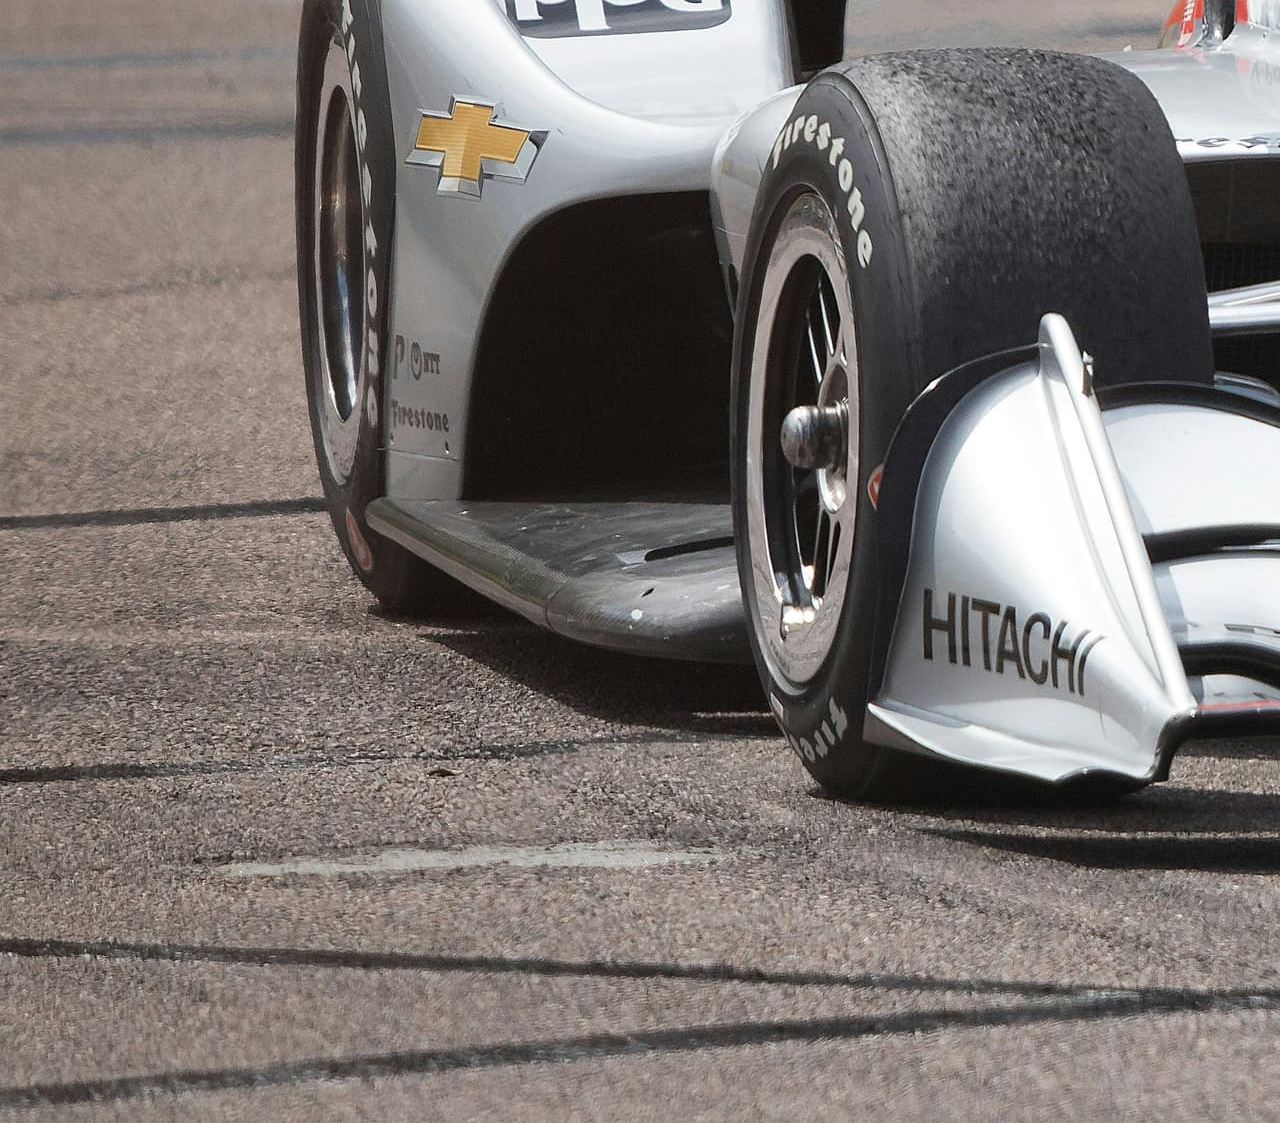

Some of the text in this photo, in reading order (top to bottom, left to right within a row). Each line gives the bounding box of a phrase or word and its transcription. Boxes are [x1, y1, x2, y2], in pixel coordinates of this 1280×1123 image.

[772, 113, 874, 269] Firestone
[392, 398, 450, 433] Firestone
[922, 587, 1104, 698] HITACHI
